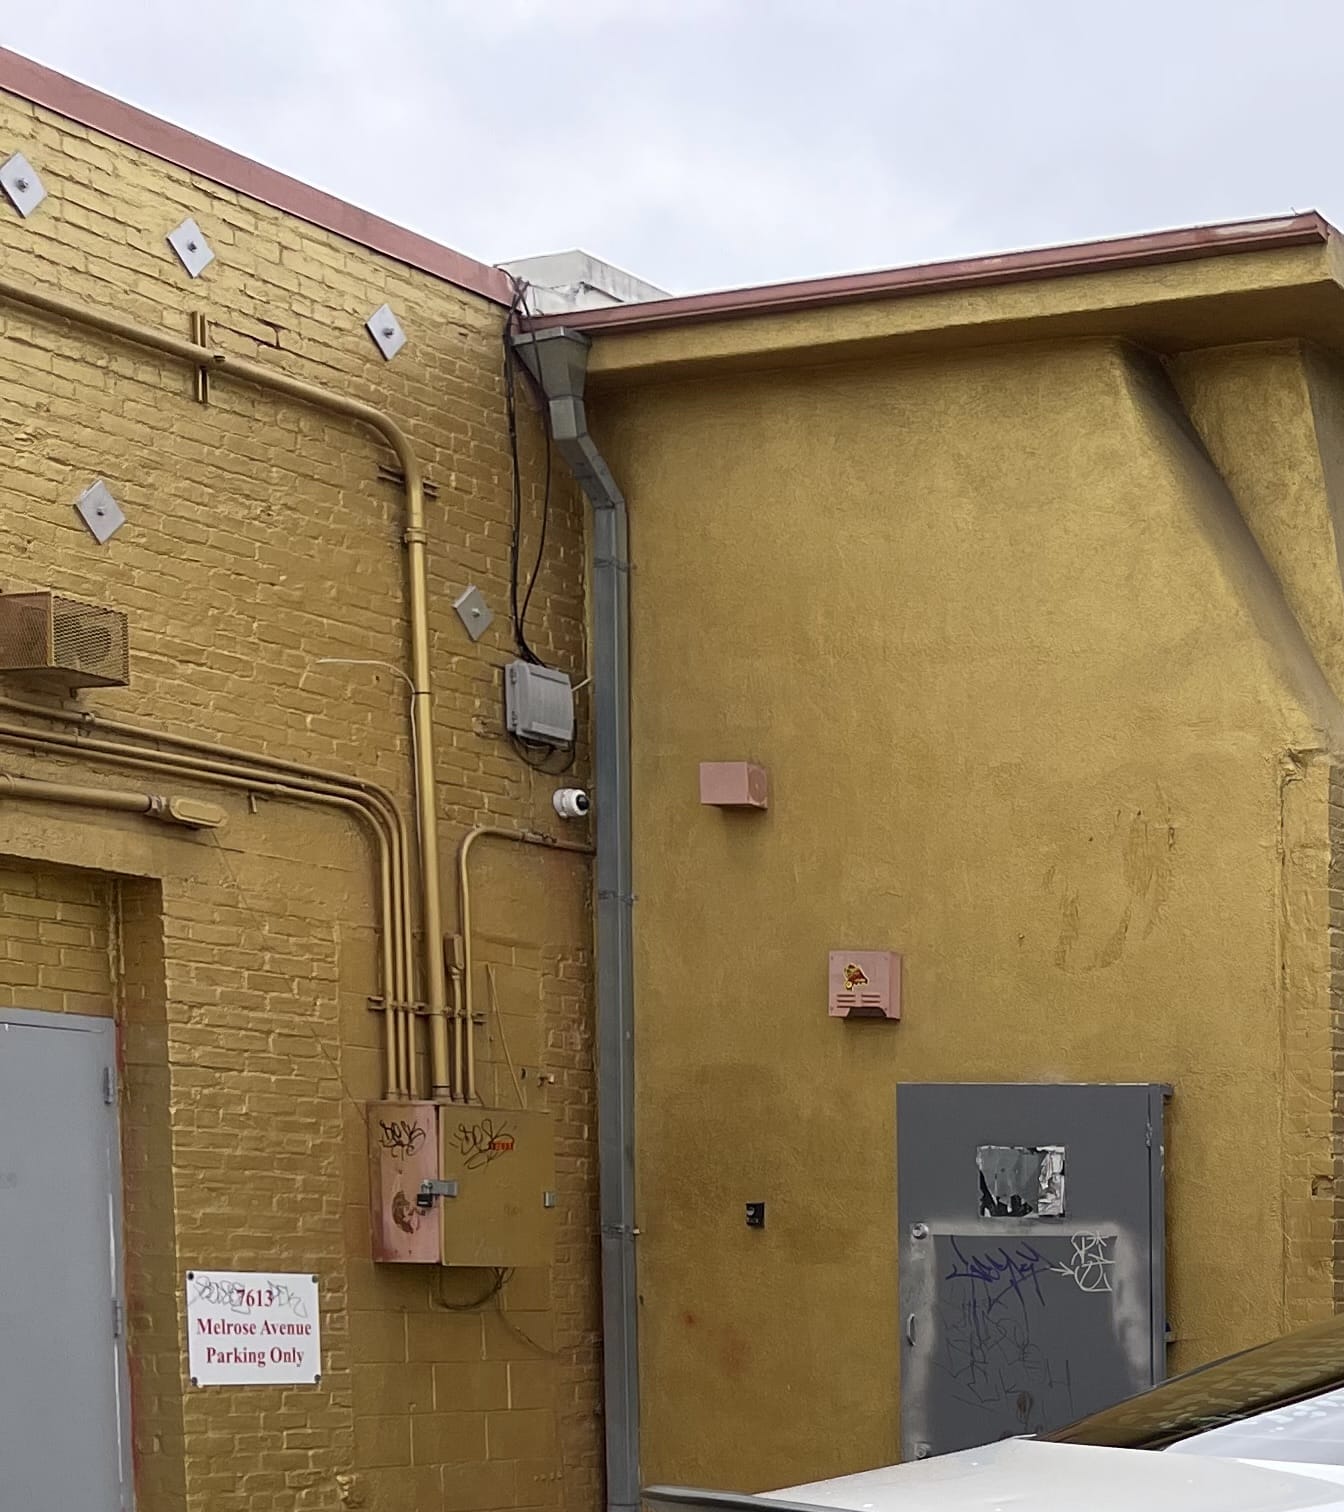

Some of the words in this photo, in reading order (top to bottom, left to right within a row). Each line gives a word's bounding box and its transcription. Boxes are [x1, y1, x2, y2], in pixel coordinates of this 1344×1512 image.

[236, 1289, 273, 1307] 7613
[197, 1318, 257, 1336] Melrose
[260, 1319, 312, 1336] Avenue
[206, 1347, 266, 1367] Parking
[270, 1346, 304, 1367] Only
